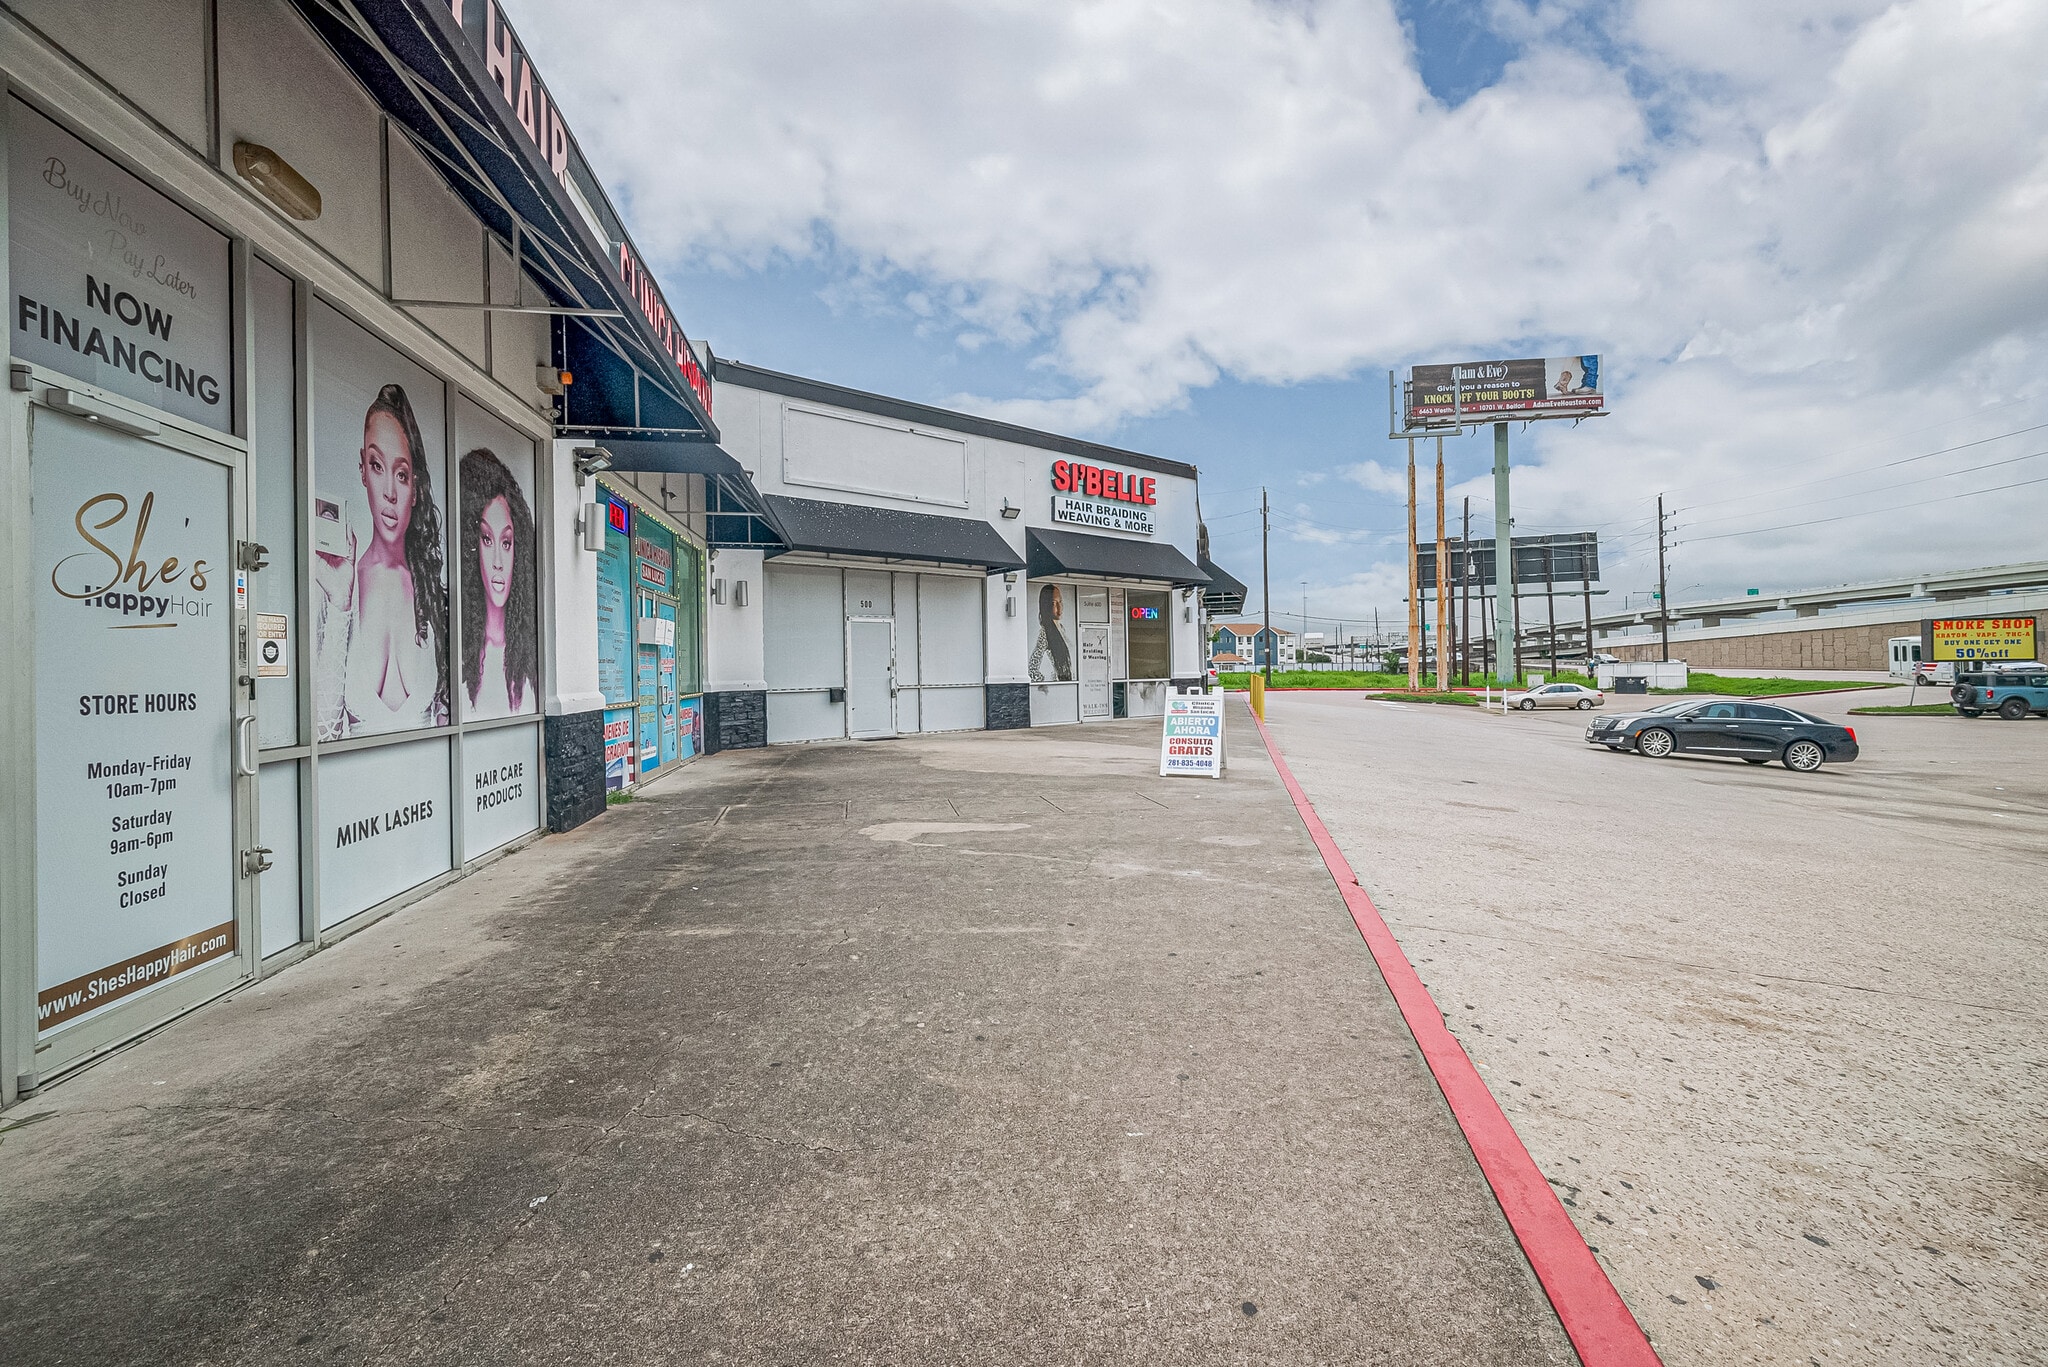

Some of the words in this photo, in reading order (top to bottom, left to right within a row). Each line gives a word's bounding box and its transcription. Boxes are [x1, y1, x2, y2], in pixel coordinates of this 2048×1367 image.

[486, 0, 568, 193] HAIR
[43, 157, 91, 213] Buy
[93, 191, 147, 236] Now
[105, 229, 144, 278] Pay
[147, 255, 196, 299] Later
[86, 273, 173, 342] NOW
[18, 294, 220, 405] FINANCING
[1477, 366, 1485, 378] &
[1486, 364, 1503, 378] Eve
[1424, 394, 1453, 404] KNOCK
[1475, 391, 1499, 401] YOUR
[1502, 389, 1535, 400] BOOTS!
[1460, 384, 1475, 392] you
[1532, 399, 1602, 408] AdamEveHouston.com
[1053, 459, 1157, 505] SI'BELLE
[1057, 510, 1110, 527] WEAVING
[1114, 519, 1121, 529] &
[1124, 521, 1154, 533] MORE
[1065, 500, 1093, 513] HAIR
[1096, 505, 1147, 522] BRAIDING
[52, 491, 215, 599] She's
[860, 600, 873, 609] 500
[1131, 607, 1159, 619] OPEN
[1933, 620, 1985, 630] SMOKE
[1991, 619, 2034, 629] SHOP
[79, 694, 139, 716] STORE
[145, 693, 197, 713] HOURS
[1170, 717, 1216, 726] ABIERTO
[1173, 726, 1211, 735] AHORA
[1168, 746, 1213, 756] GRATIS
[1169, 737, 1214, 746] CONSULTA
[87, 754, 192, 780] Monday-Friday
[475, 769, 498, 790] HAIR
[500, 762, 523, 782] CARE
[106, 777, 177, 799] 10am-7pm
[476, 783, 523, 812] PRODUCTS
[111, 809, 172, 832] Saturday
[336, 815, 380, 849] MINK
[385, 800, 433, 832] LASHES
[110, 831, 173, 855] 9am-6pm
[117, 864, 168, 887] Sunday
[119, 882, 166, 909] Closed
[38, 933, 227, 1020] www.ShesHappyHair.com
